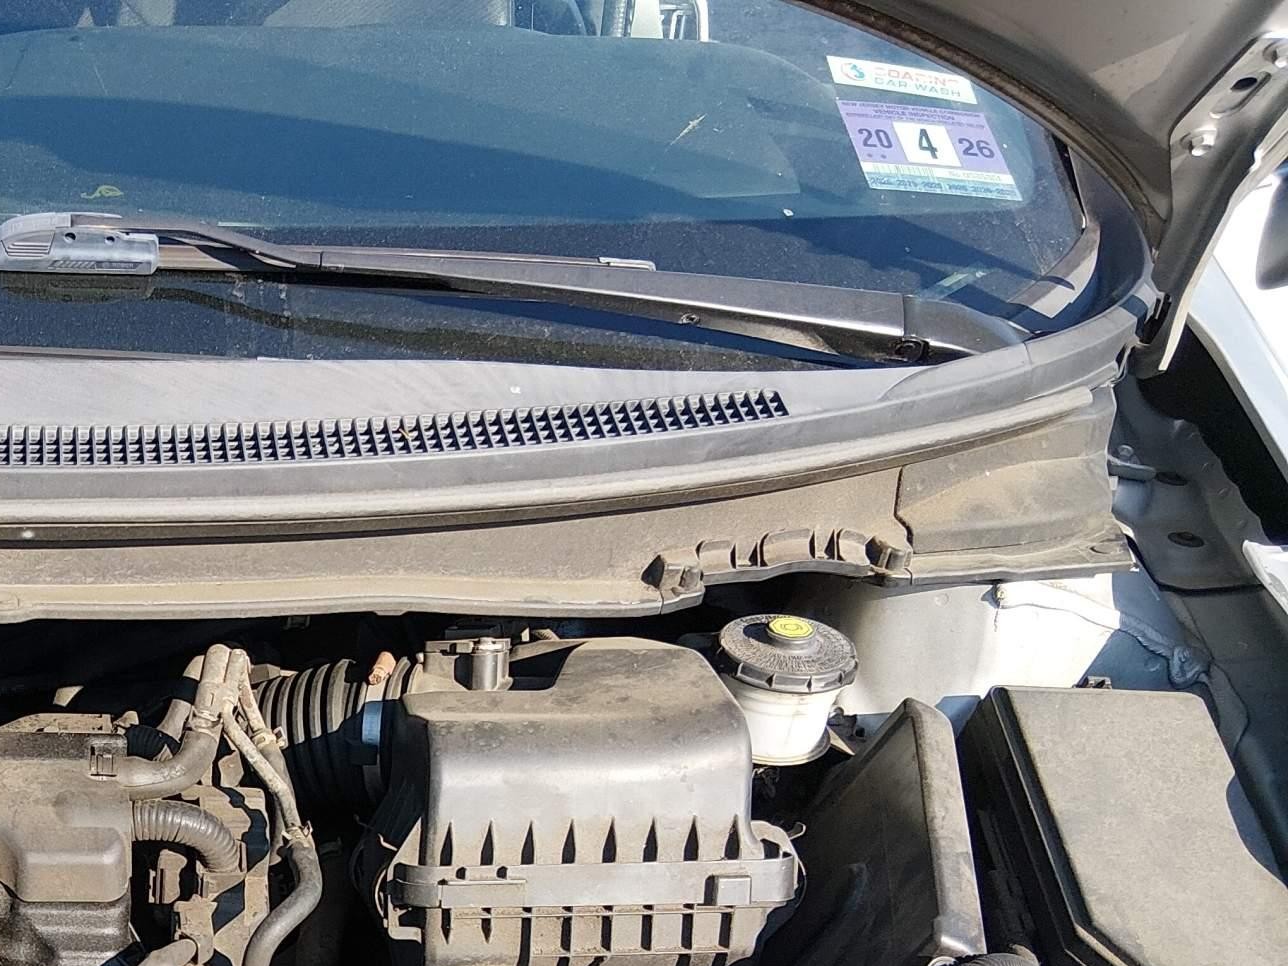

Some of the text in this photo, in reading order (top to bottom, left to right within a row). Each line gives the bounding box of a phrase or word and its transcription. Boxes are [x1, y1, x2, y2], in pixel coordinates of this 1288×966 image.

[874, 77, 961, 97] CAR WASH
[858, 128, 995, 159] 20 4 26
